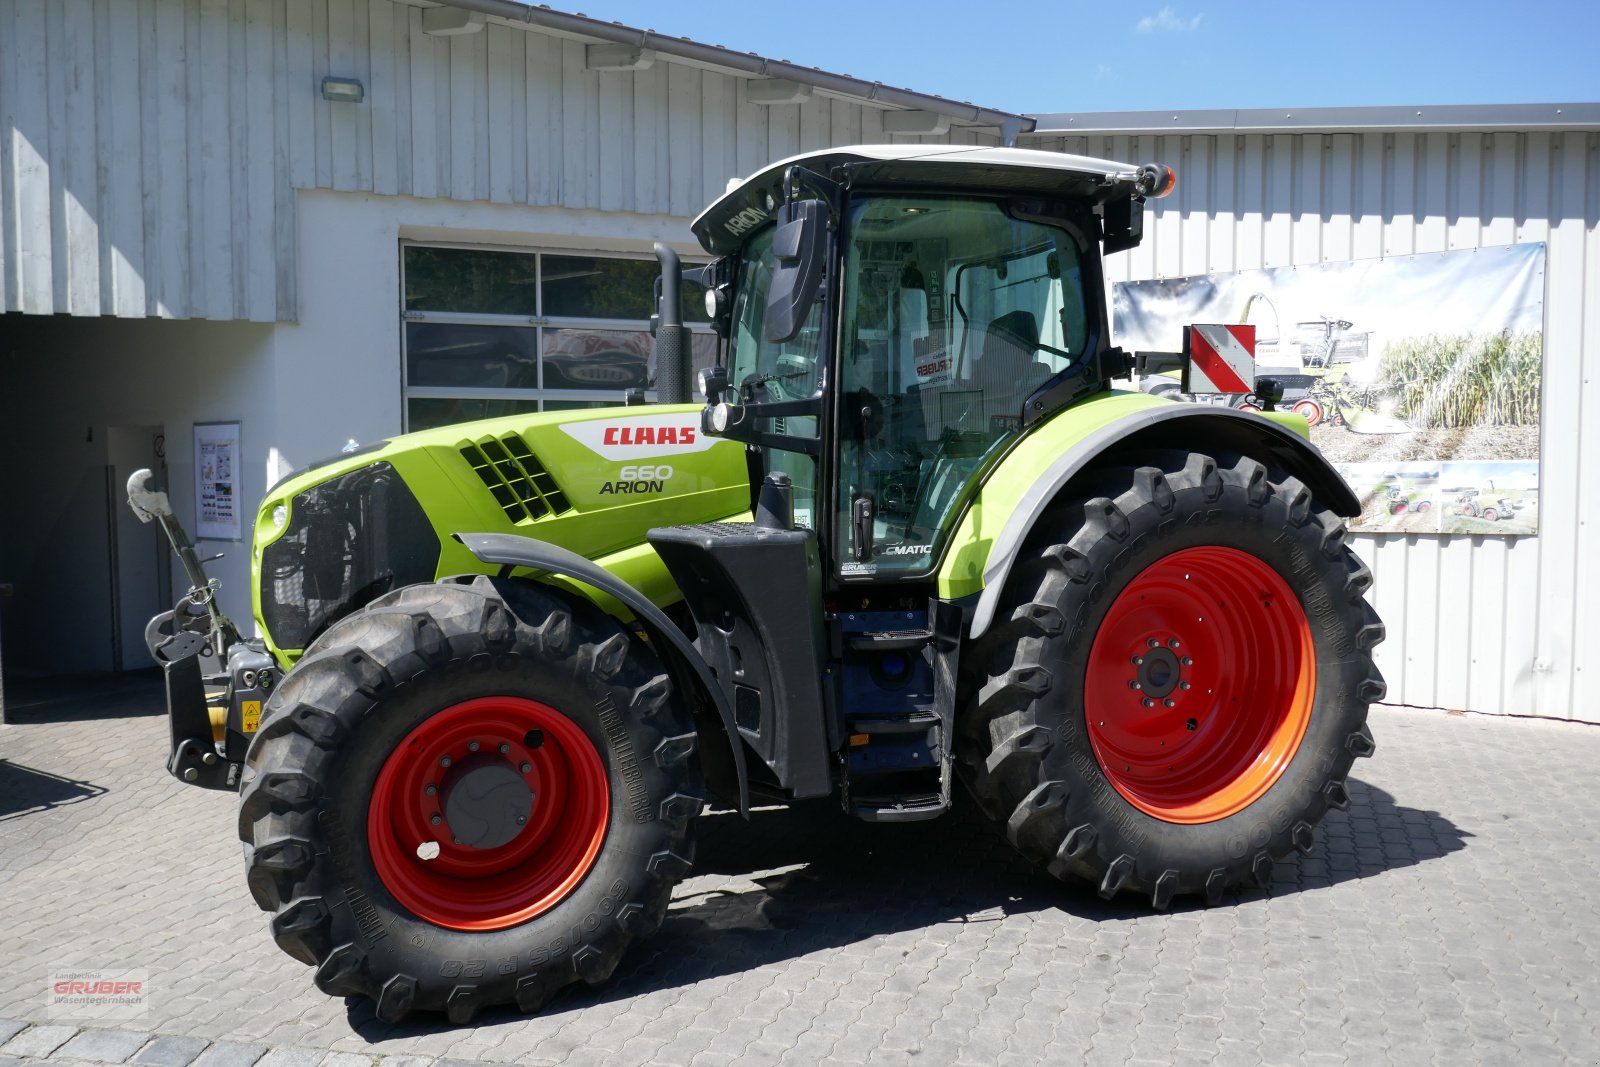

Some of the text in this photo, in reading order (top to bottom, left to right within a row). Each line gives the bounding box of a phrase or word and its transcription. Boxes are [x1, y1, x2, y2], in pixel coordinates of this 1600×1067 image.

[723, 207, 769, 237] ARION
[603, 427, 696, 445] CLAAS
[620, 465, 674, 481] 660
[599, 480, 664, 494] ARION
[593, 691, 656, 825] TRELLEBORG
[1057, 718, 1148, 849] TRELLEBORG
[440, 959, 488, 979] 28
[496, 955, 519, 976] R
